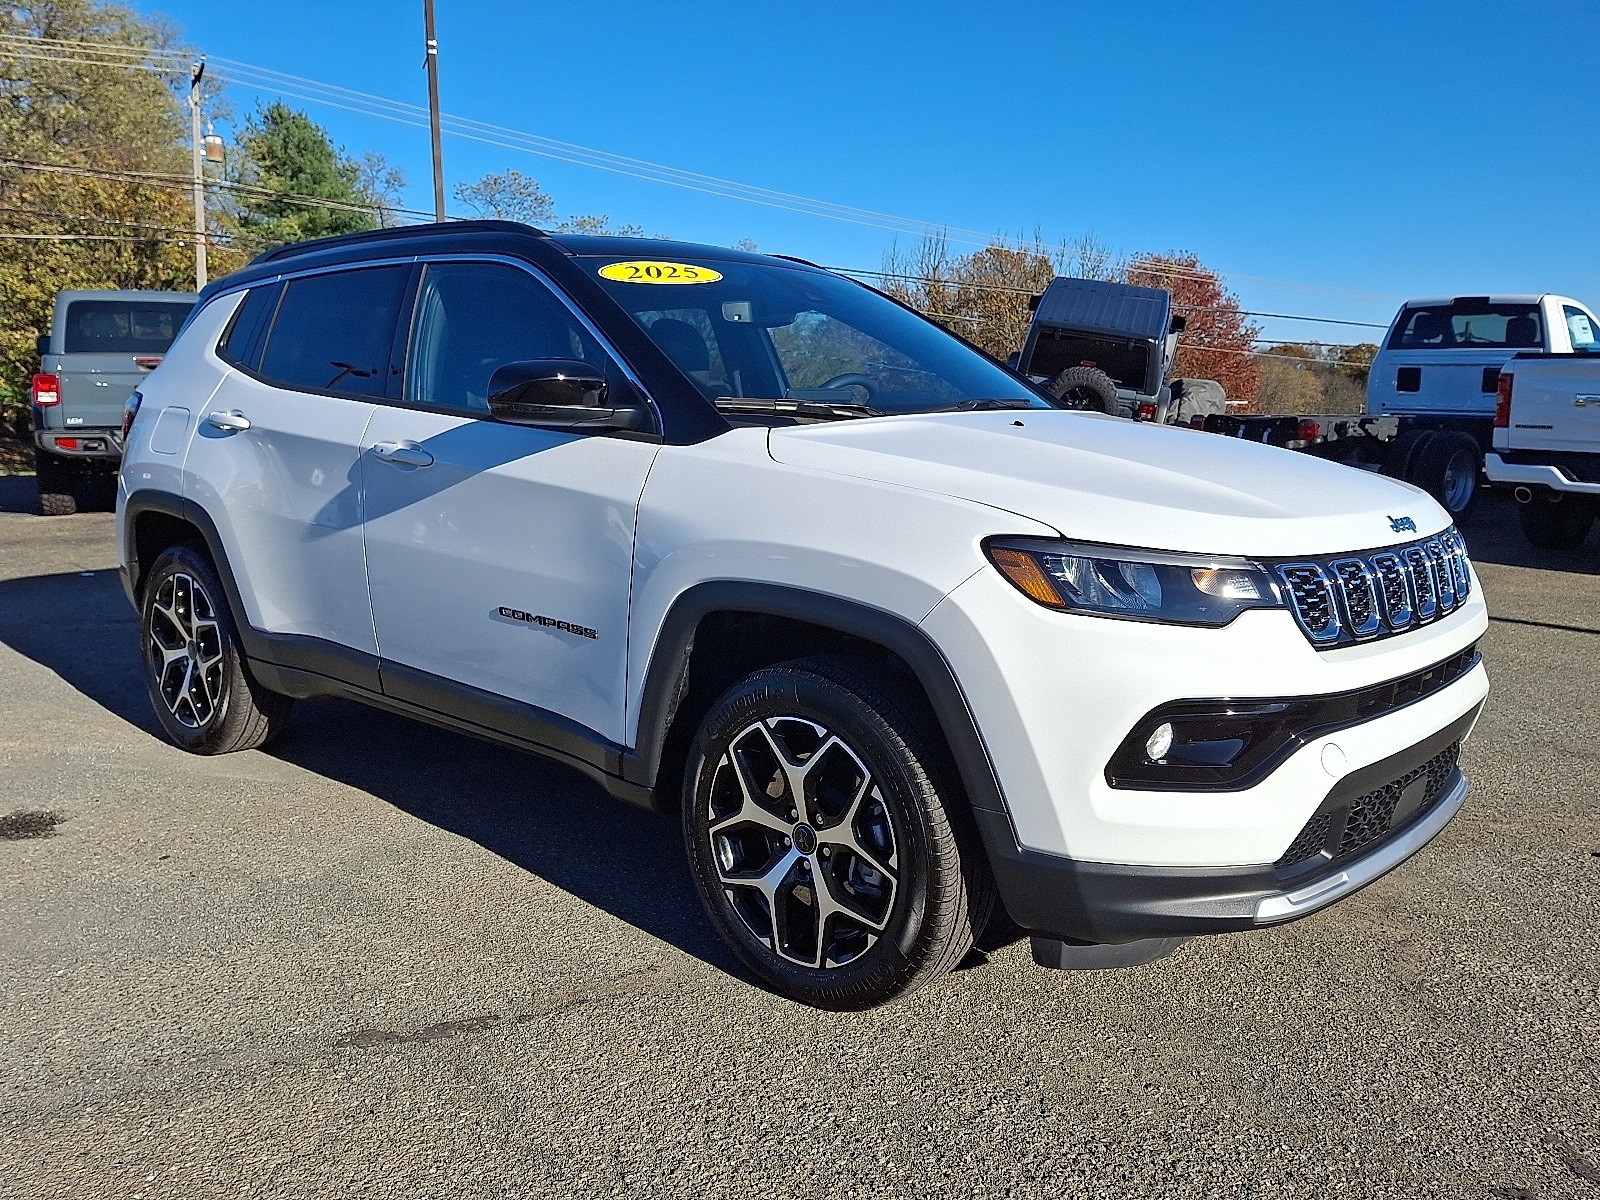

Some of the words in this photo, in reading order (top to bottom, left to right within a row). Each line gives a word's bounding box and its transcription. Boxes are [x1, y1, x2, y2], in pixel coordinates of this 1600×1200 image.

[624, 265, 699, 280] 2025
[1386, 515, 1417, 533] Jeep
[498, 606, 599, 640] COMPASS
